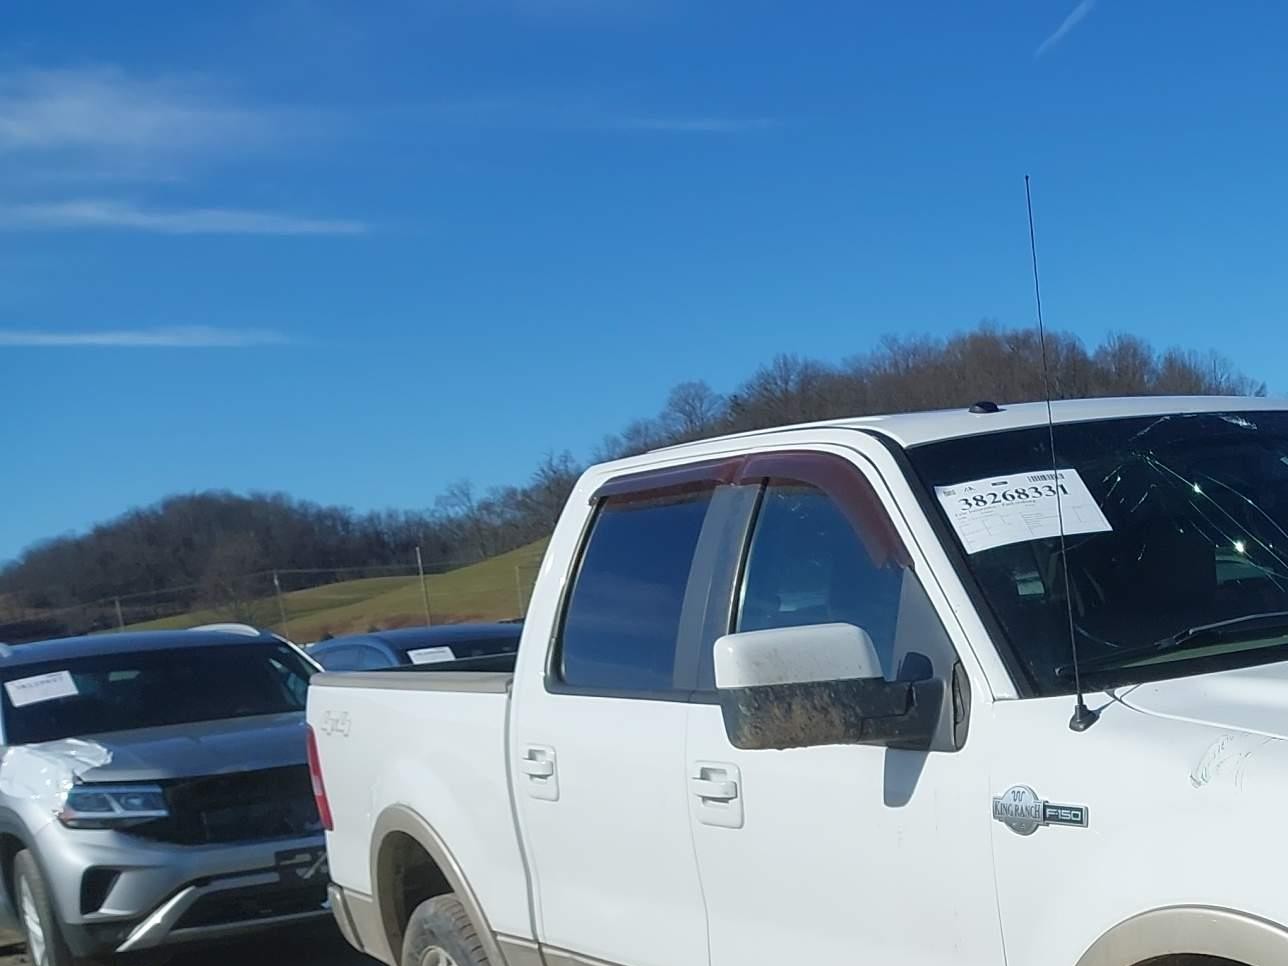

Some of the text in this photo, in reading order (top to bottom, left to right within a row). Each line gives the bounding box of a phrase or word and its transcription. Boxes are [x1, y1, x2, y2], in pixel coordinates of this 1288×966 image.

[958, 484, 1069, 511] 38268331
[994, 802, 1041, 819] KING RANCH
[1045, 808, 1082, 821] F-150
